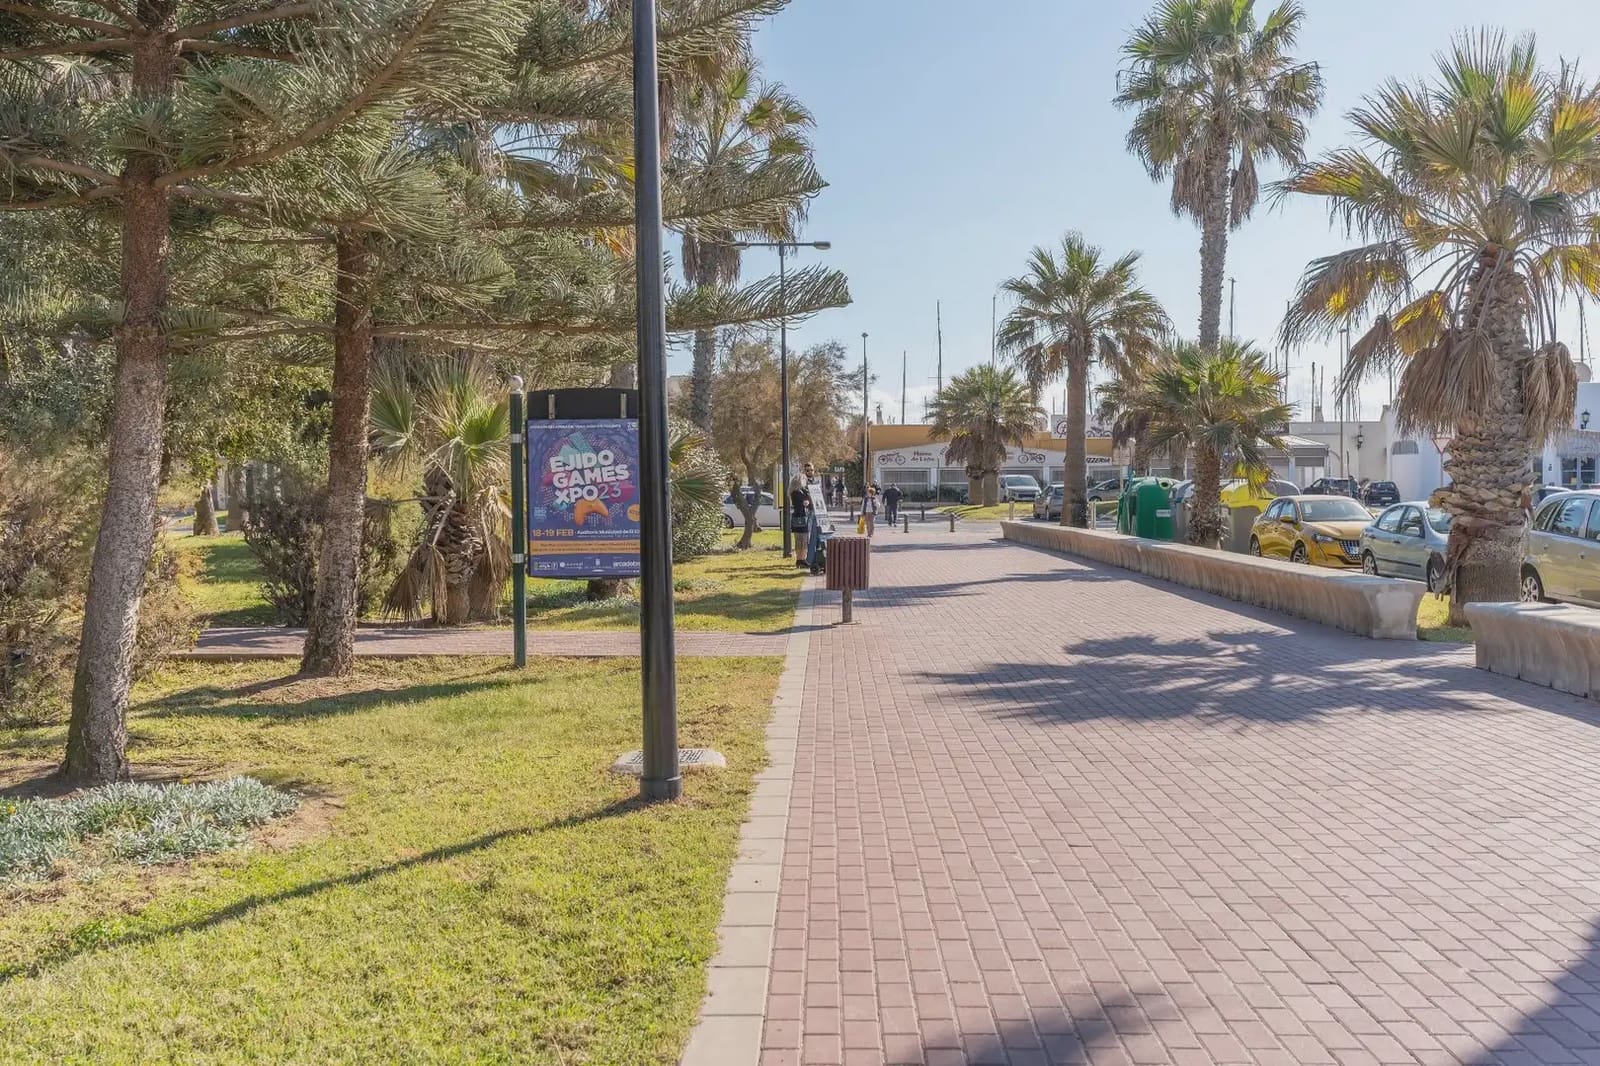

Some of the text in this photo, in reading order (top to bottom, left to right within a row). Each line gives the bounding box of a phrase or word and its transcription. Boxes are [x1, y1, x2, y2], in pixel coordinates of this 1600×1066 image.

[550, 450, 614, 472] EJIDO
[553, 464, 630, 488] GAMES
[533, 529, 574, 537] 18-19 FEB
